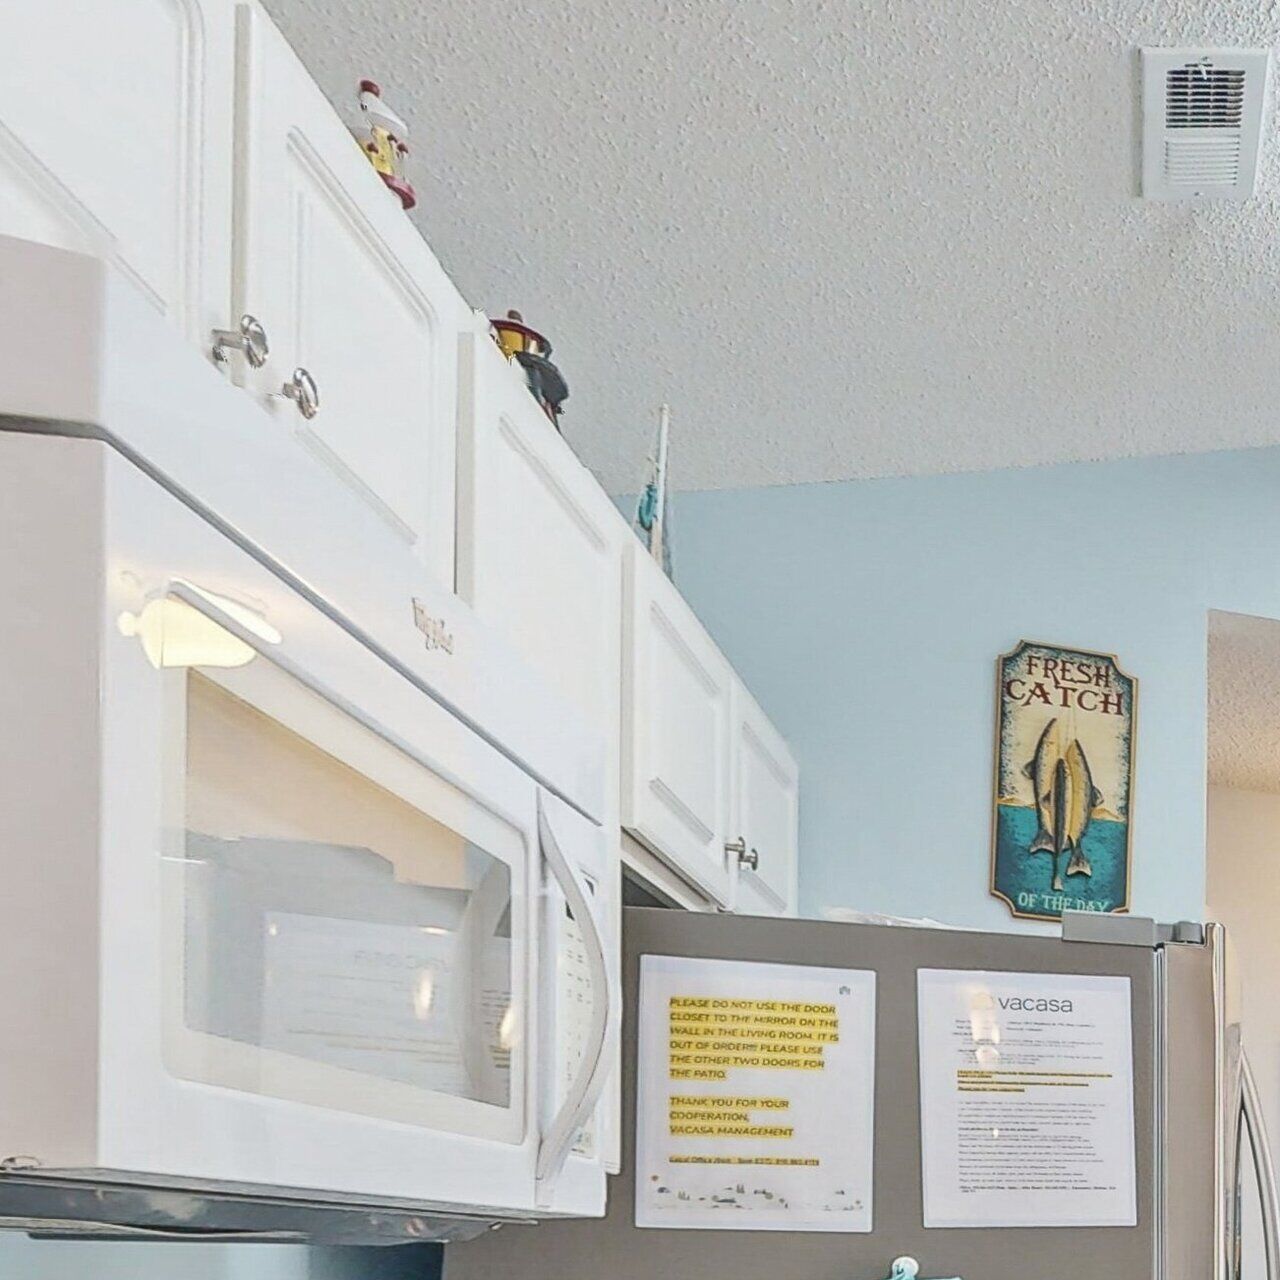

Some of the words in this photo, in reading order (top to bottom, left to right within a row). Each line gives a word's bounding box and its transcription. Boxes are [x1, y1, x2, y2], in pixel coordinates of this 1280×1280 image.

[1025, 654, 1111, 689] FRESH
[1005, 678, 1124, 717] CATCH
[1018, 891, 1038, 908] OF
[1041, 894, 1072, 911] THE
[1076, 898, 1110, 912] DAY
[670, 997, 709, 1008] PLEASE
[712, 1000, 728, 1008] DO
[732, 1001, 753, 1009] NOT
[756, 1002, 776, 1011] USE
[781, 1003, 801, 1012] THE
[804, 1004, 836, 1014] DOOR
[998, 996, 1074, 1014] vacasa
[670, 1012, 709, 1021] CLOSET
[714, 1014, 727, 1022] TO
[731, 1014, 750, 1023] THE
[754, 1016, 796, 1026] MIRROR
[799, 1018, 815, 1027] ON
[819, 1019, 839, 1028] THE
[670, 1027, 700, 1036] WALL
[704, 1028, 714, 1036] IN
[718, 1028, 738, 1037] THE
[741, 1029, 776, 1039] LIVING
[817, 1033, 828, 1041] IT
[830, 1034, 839, 1042] IS
[670, 1040, 692, 1049] OUT
[696, 1041, 709, 1050] OF
[760, 1044, 800, 1053] PLEASE
[803, 1046, 824, 1055] USE
[670, 1055, 692, 1064] THE
[694, 1056, 730, 1065] OTHER
[733, 1057, 759, 1066] TWO
[762, 1058, 800, 1067] DOORS
[804, 1060, 825, 1069] FOR
[670, 1069, 692, 1078] THE
[670, 1097, 707, 1106] THANK
[711, 1098, 733, 1107] YOU
[736, 1099, 757, 1107] FOR
[760, 1100, 789, 1109] YOUR
[670, 1125, 714, 1135] VACASA
[717, 1127, 794, 1137] MANAGEMENT
